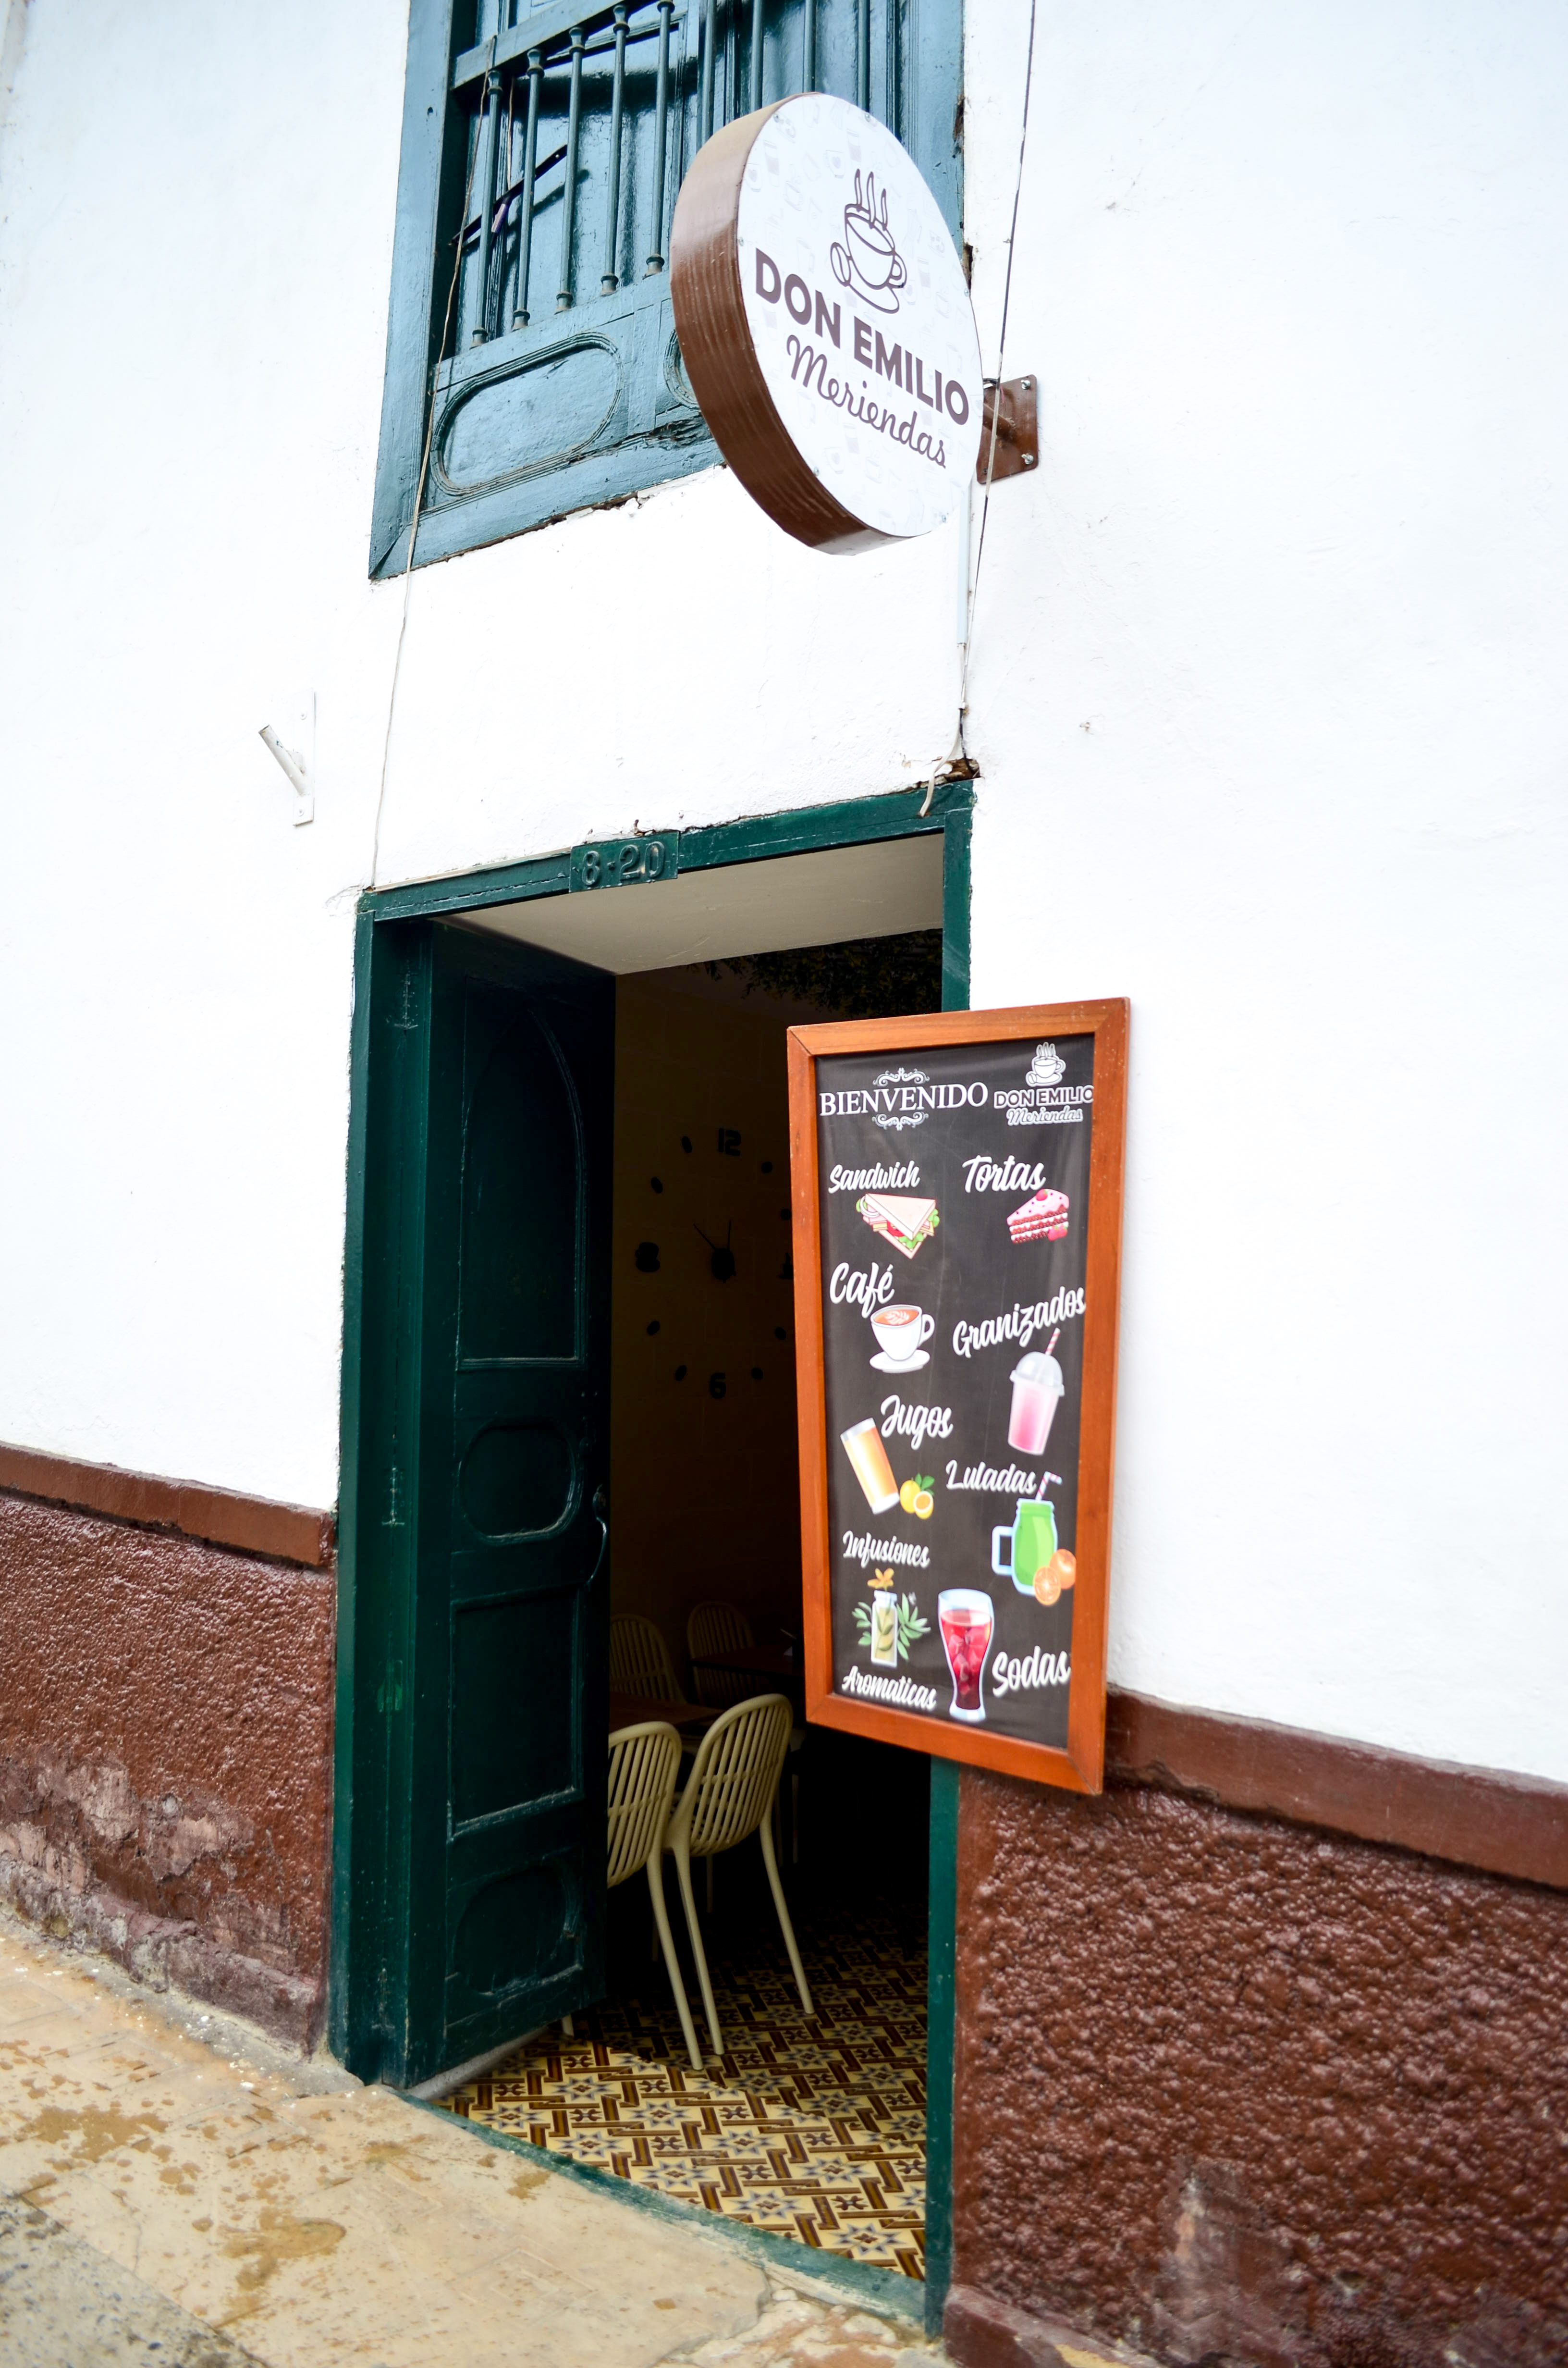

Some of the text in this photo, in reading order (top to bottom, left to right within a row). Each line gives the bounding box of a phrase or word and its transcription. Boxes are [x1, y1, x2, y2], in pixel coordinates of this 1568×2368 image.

[756, 248, 969, 425] DON EMILIO
[786, 334, 946, 469] Meriendas
[820, 1082, 988, 1116] BIENVENIDO
[994, 1085, 1093, 1109] DON EMILIO
[1006, 1105, 1083, 1125] Meriendas
[828, 1160, 920, 1193] Sandwich
[962, 1155, 1046, 1192] Tortas
[830, 1262, 894, 1318] Café
[953, 1286, 1086, 1358] Granizados
[881, 1394, 953, 1450] Jugos
[945, 1460, 1037, 1493] Luladas
[843, 1530, 930, 1568] Infusiones
[842, 1665, 937, 1711] Aromaticas
[992, 1645, 1071, 1698] Sodas
